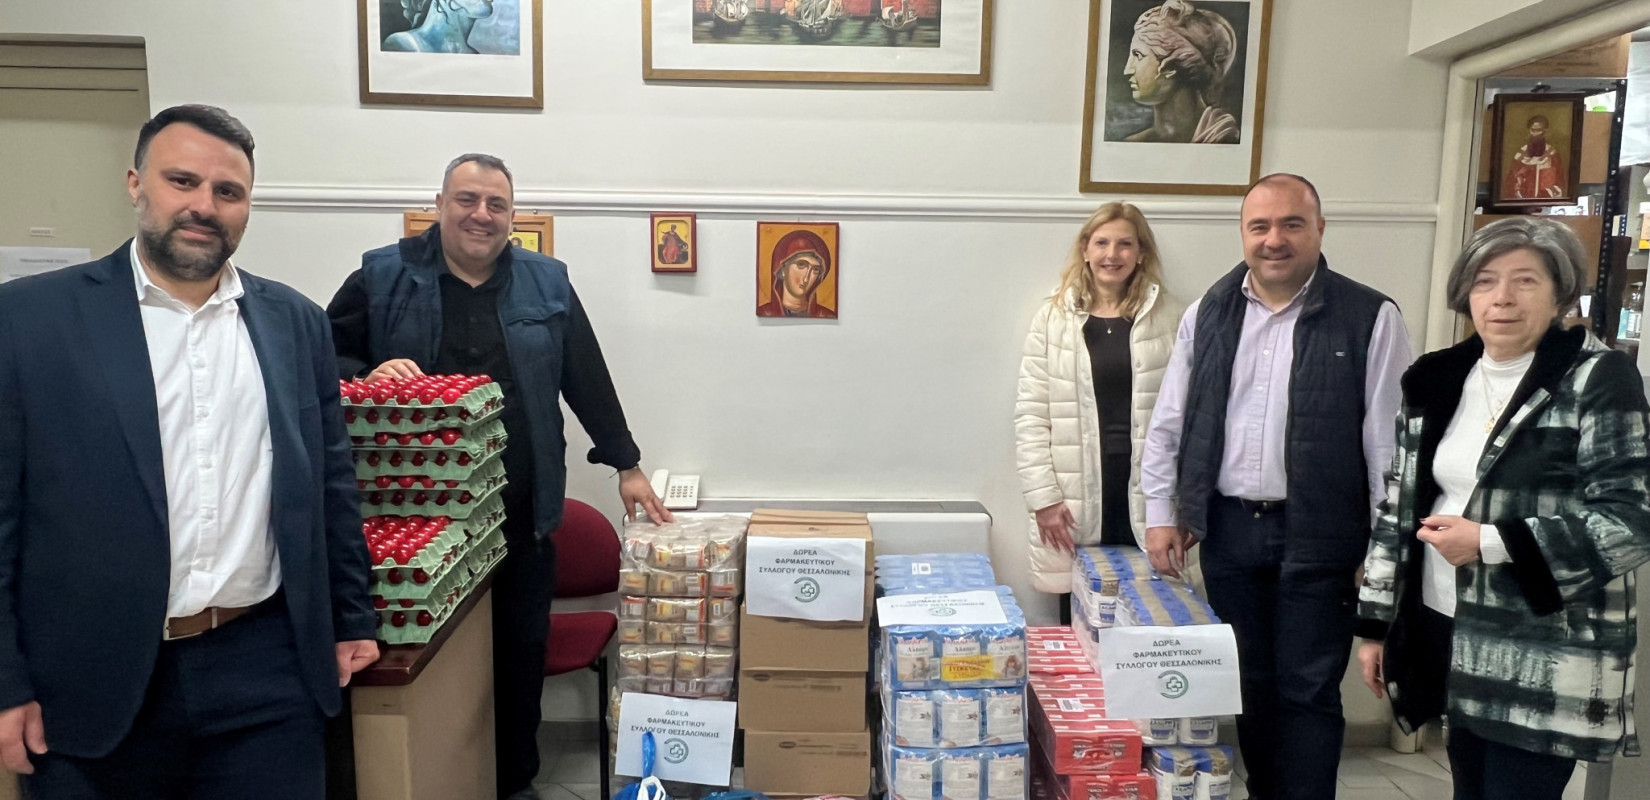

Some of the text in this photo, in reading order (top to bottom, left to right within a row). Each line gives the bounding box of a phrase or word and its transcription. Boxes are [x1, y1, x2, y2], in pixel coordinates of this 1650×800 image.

[775, 558, 835, 566] ΦΑΡΜΑΚΕΥΤΙΚΟΥ
[758, 566, 851, 576] ΣΥΛΛΟΓΟΥ ΘΕΣΣΑΛΟΝΙΚΗΣ
[1153, 639, 1181, 647] ΔΩΡΕΑ
[1132, 649, 1202, 659] ΦΑΡΜΑΚΕΥΤΙΚΟΥ
[1116, 658, 1222, 670] ΣΥΛΛΟΓΟΥ ΘΕΣΣΑΛΟΝΙΚΗΣ
[665, 709, 689, 717] ΔΩΡΕΑ
[647, 717, 706, 727] ΦΑΡΜΑΚΕΥΤΙΚΟΥ
[631, 725, 720, 739] ΣΥΛΛΟΓΟΥ ΘΕΣΣΑΛΟΝΙΚΗΣ
